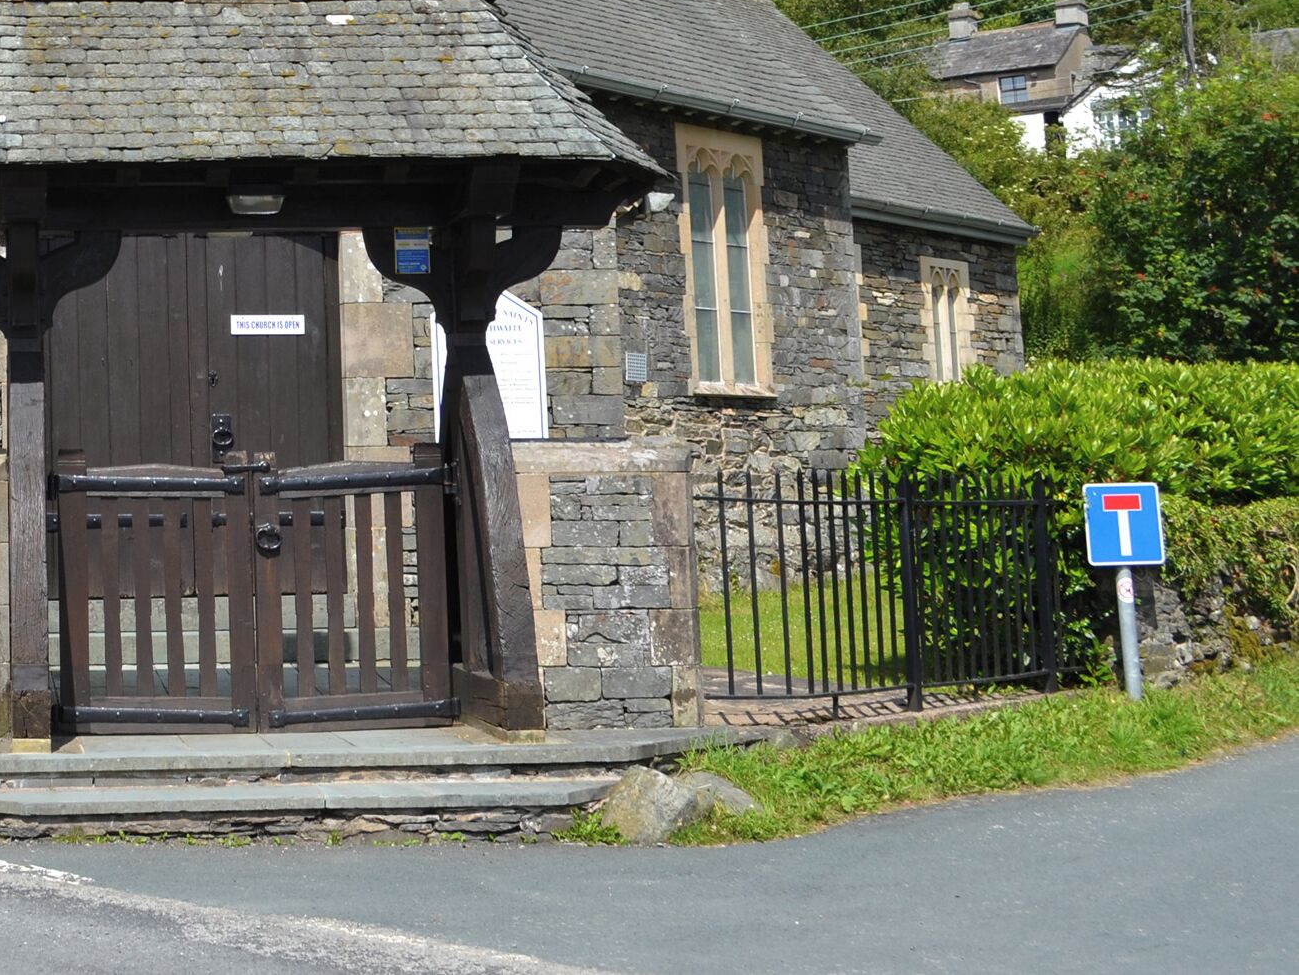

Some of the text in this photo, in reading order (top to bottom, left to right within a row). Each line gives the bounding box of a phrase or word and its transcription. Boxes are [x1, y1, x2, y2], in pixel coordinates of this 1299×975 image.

[236, 320, 299, 329] THIS CHURCH IS OPEN
